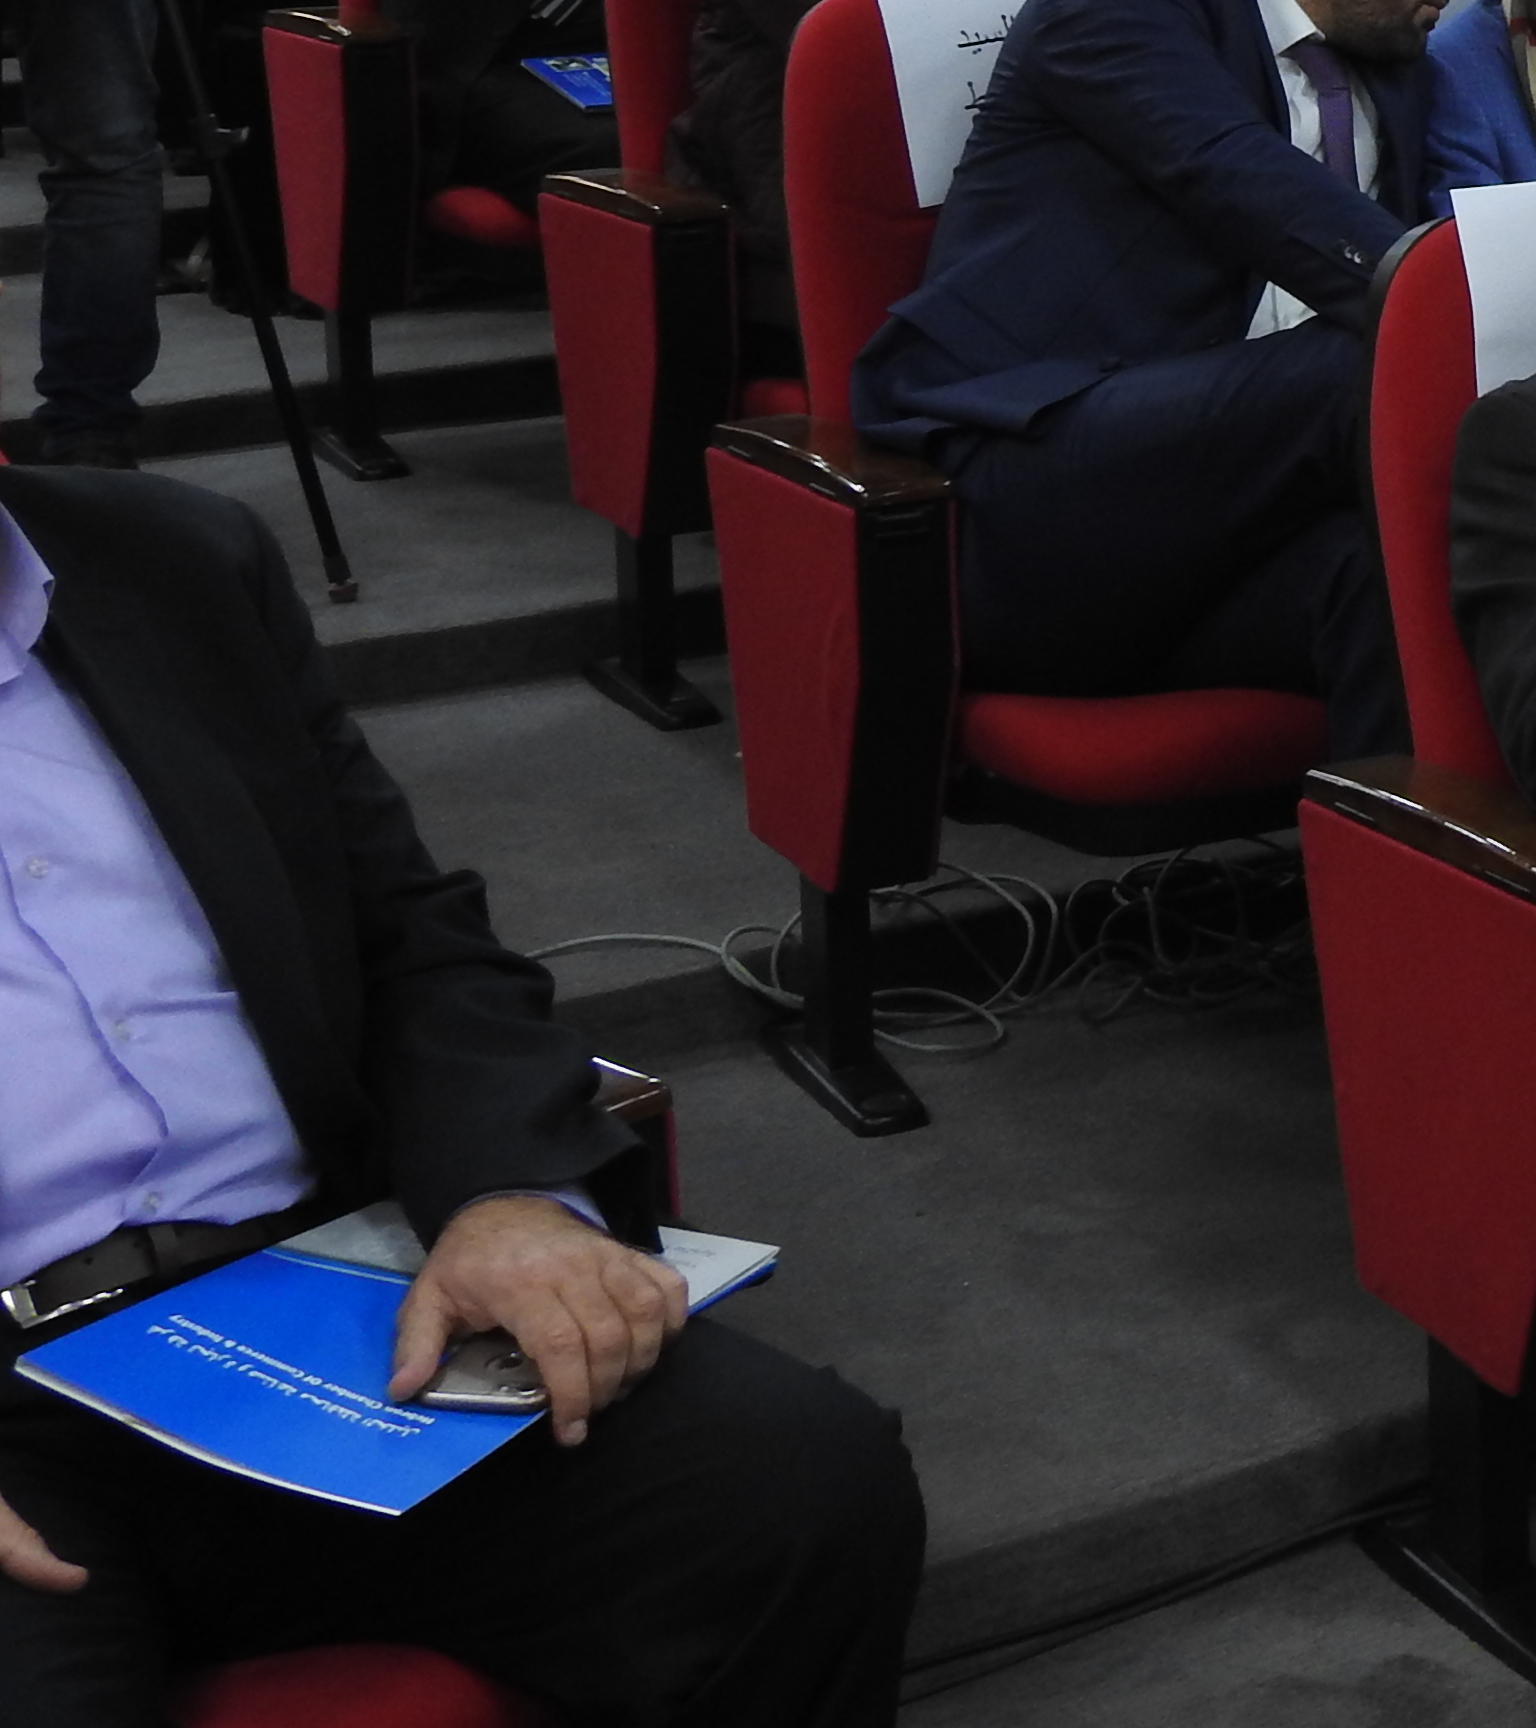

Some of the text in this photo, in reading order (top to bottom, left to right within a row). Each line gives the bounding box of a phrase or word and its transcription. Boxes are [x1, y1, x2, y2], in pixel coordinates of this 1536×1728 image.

[169, 1314, 223, 1342] Industry
[236, 1345, 305, 1378] Commerce
[304, 1375, 323, 1385] Of
[324, 1382, 383, 1409] Chamber
